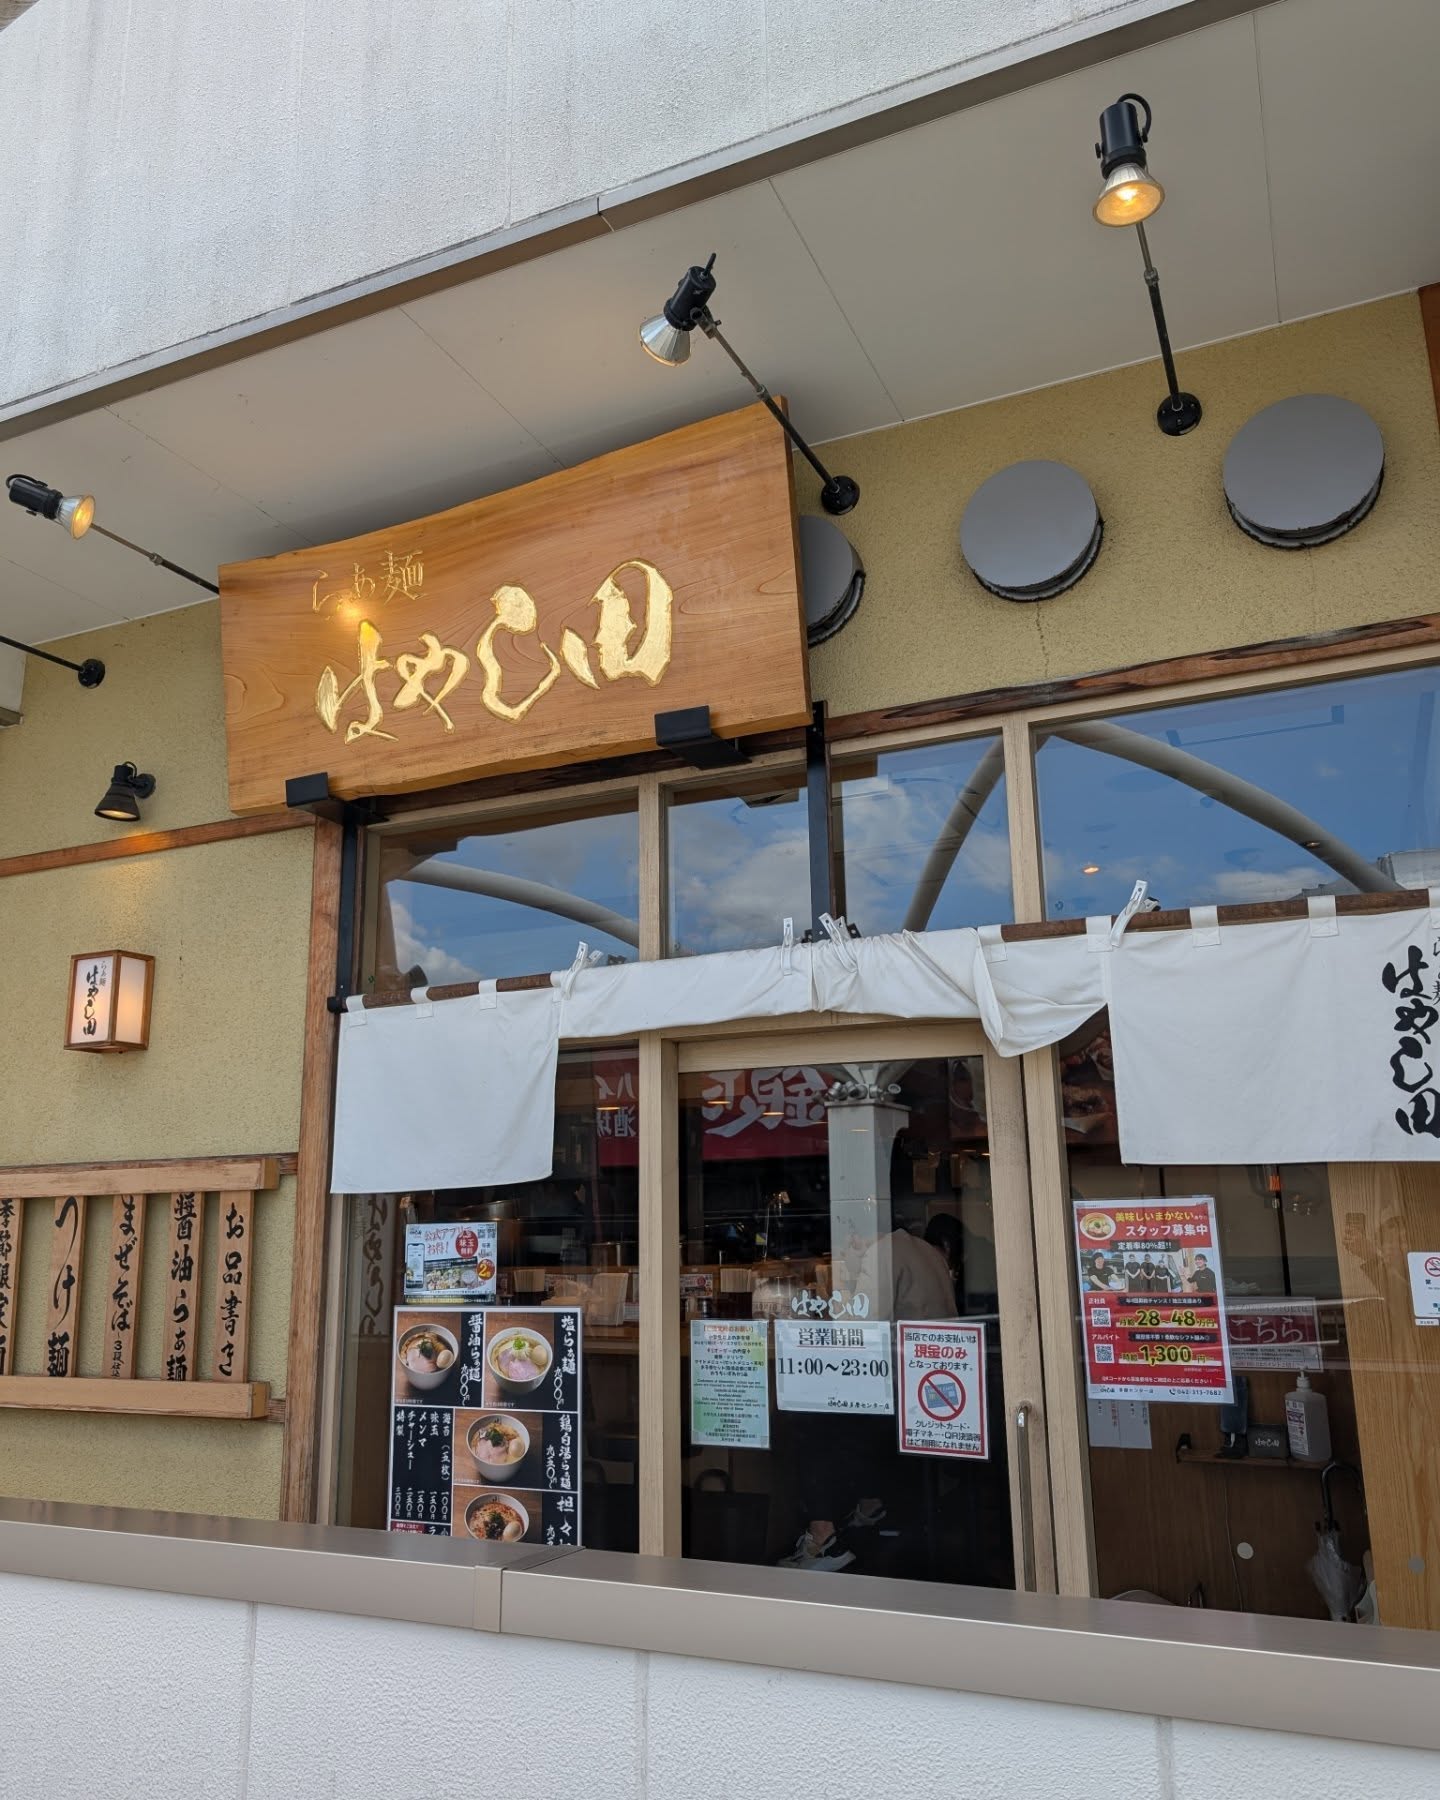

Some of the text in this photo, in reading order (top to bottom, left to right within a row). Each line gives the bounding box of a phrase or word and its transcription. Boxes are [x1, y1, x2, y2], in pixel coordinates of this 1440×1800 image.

[315, 557, 673, 745] はやし田
[83, 965, 99, 1036] はやし田
[1382, 945, 1440, 1138] はやし田
[1126, 1224, 1208, 1236] スタッフ募集中
[218, 1202, 245, 1376] お品書き
[791, 1289, 870, 1320] はやし田
[467, 1313, 483, 1382] 醤油らぁ麺
[561, 1315, 577, 1374] 塩らぁ麺
[798, 1327, 864, 1346] 営業時間
[905, 1332, 976, 1344] 当店でのお支払いは
[1230, 1316, 1303, 1344] こちら
[908, 1360, 973, 1371] となっております。
[914, 1344, 968, 1360] 現金のみ
[407, 1410, 416, 1470] チャーシュー
[418, 1411, 427, 1447] メンマ
[907, 1438, 980, 1451] はご利用になれません
[556, 1496, 575, 1546] 担々
